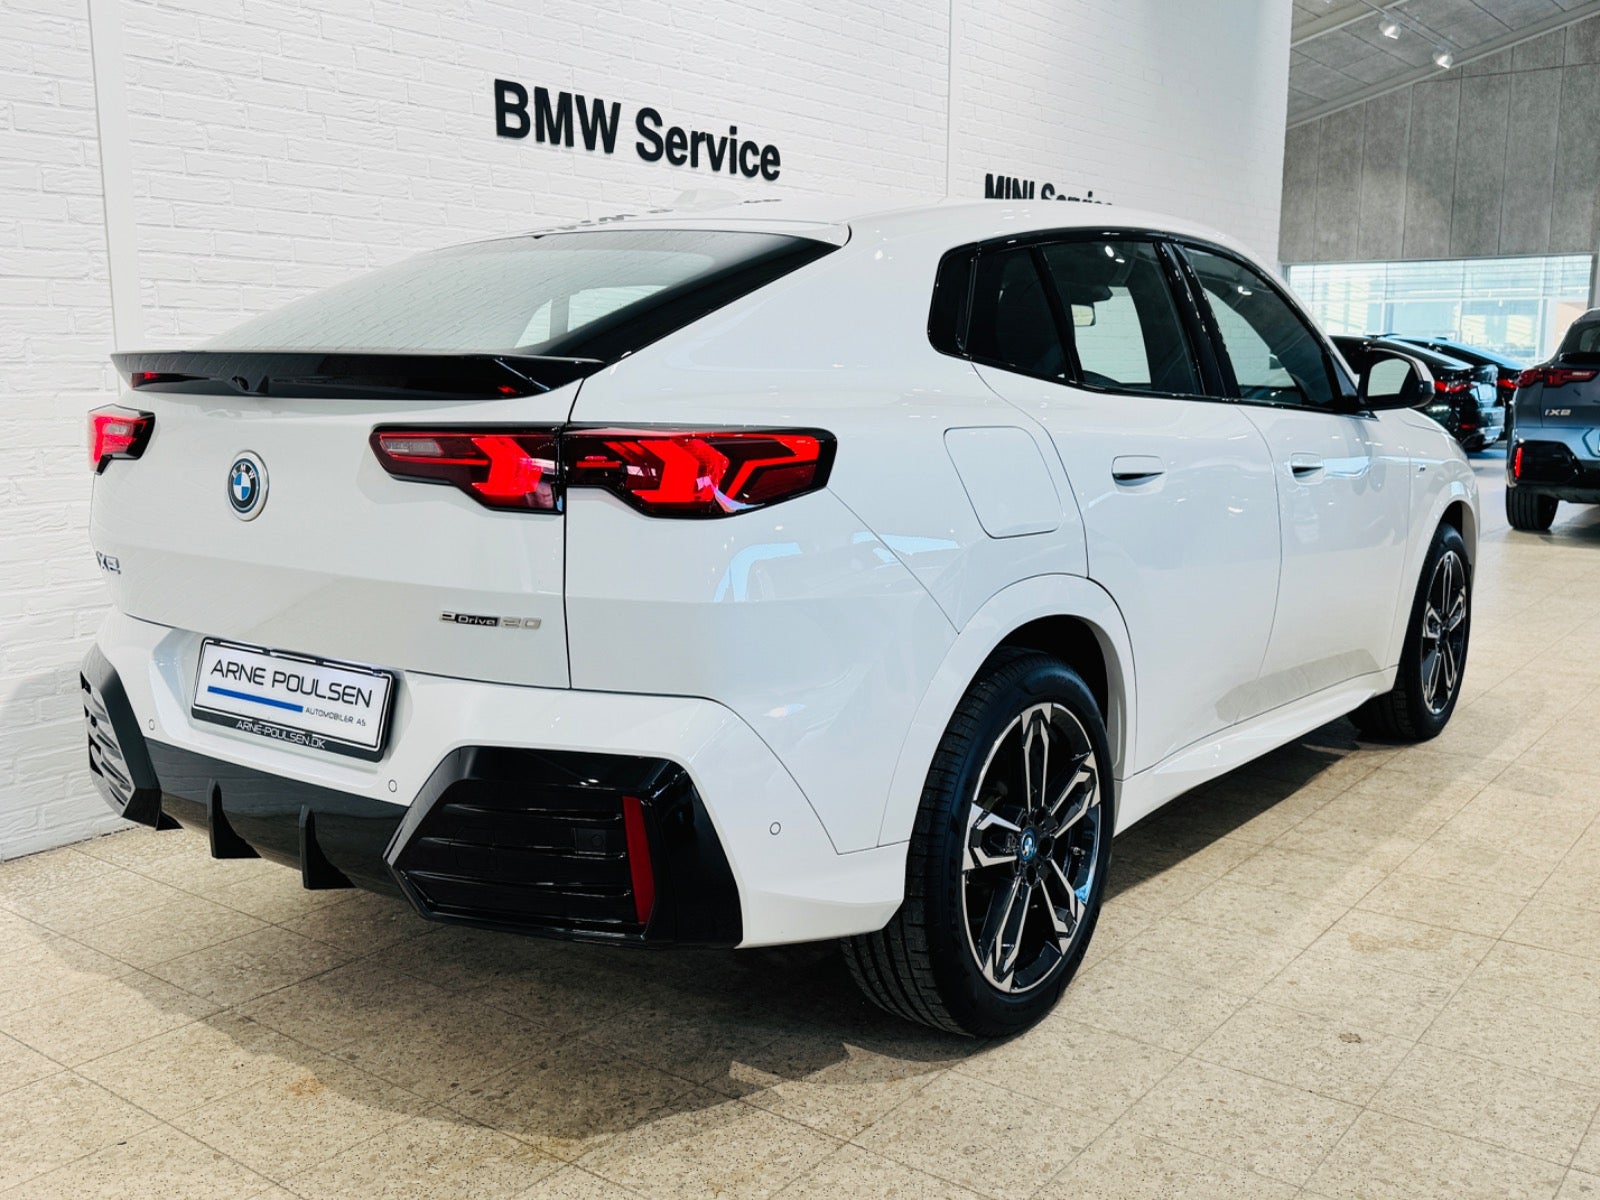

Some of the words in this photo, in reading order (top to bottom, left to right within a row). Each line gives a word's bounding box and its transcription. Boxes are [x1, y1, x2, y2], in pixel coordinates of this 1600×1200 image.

[494, 78, 621, 154] BMW
[635, 107, 781, 181] Service
[984, 173, 1035, 200] MINI
[210, 659, 266, 686] ARNE
[271, 670, 373, 708] POULSEN
[305, 706, 354, 724] AUTOMOBILER
